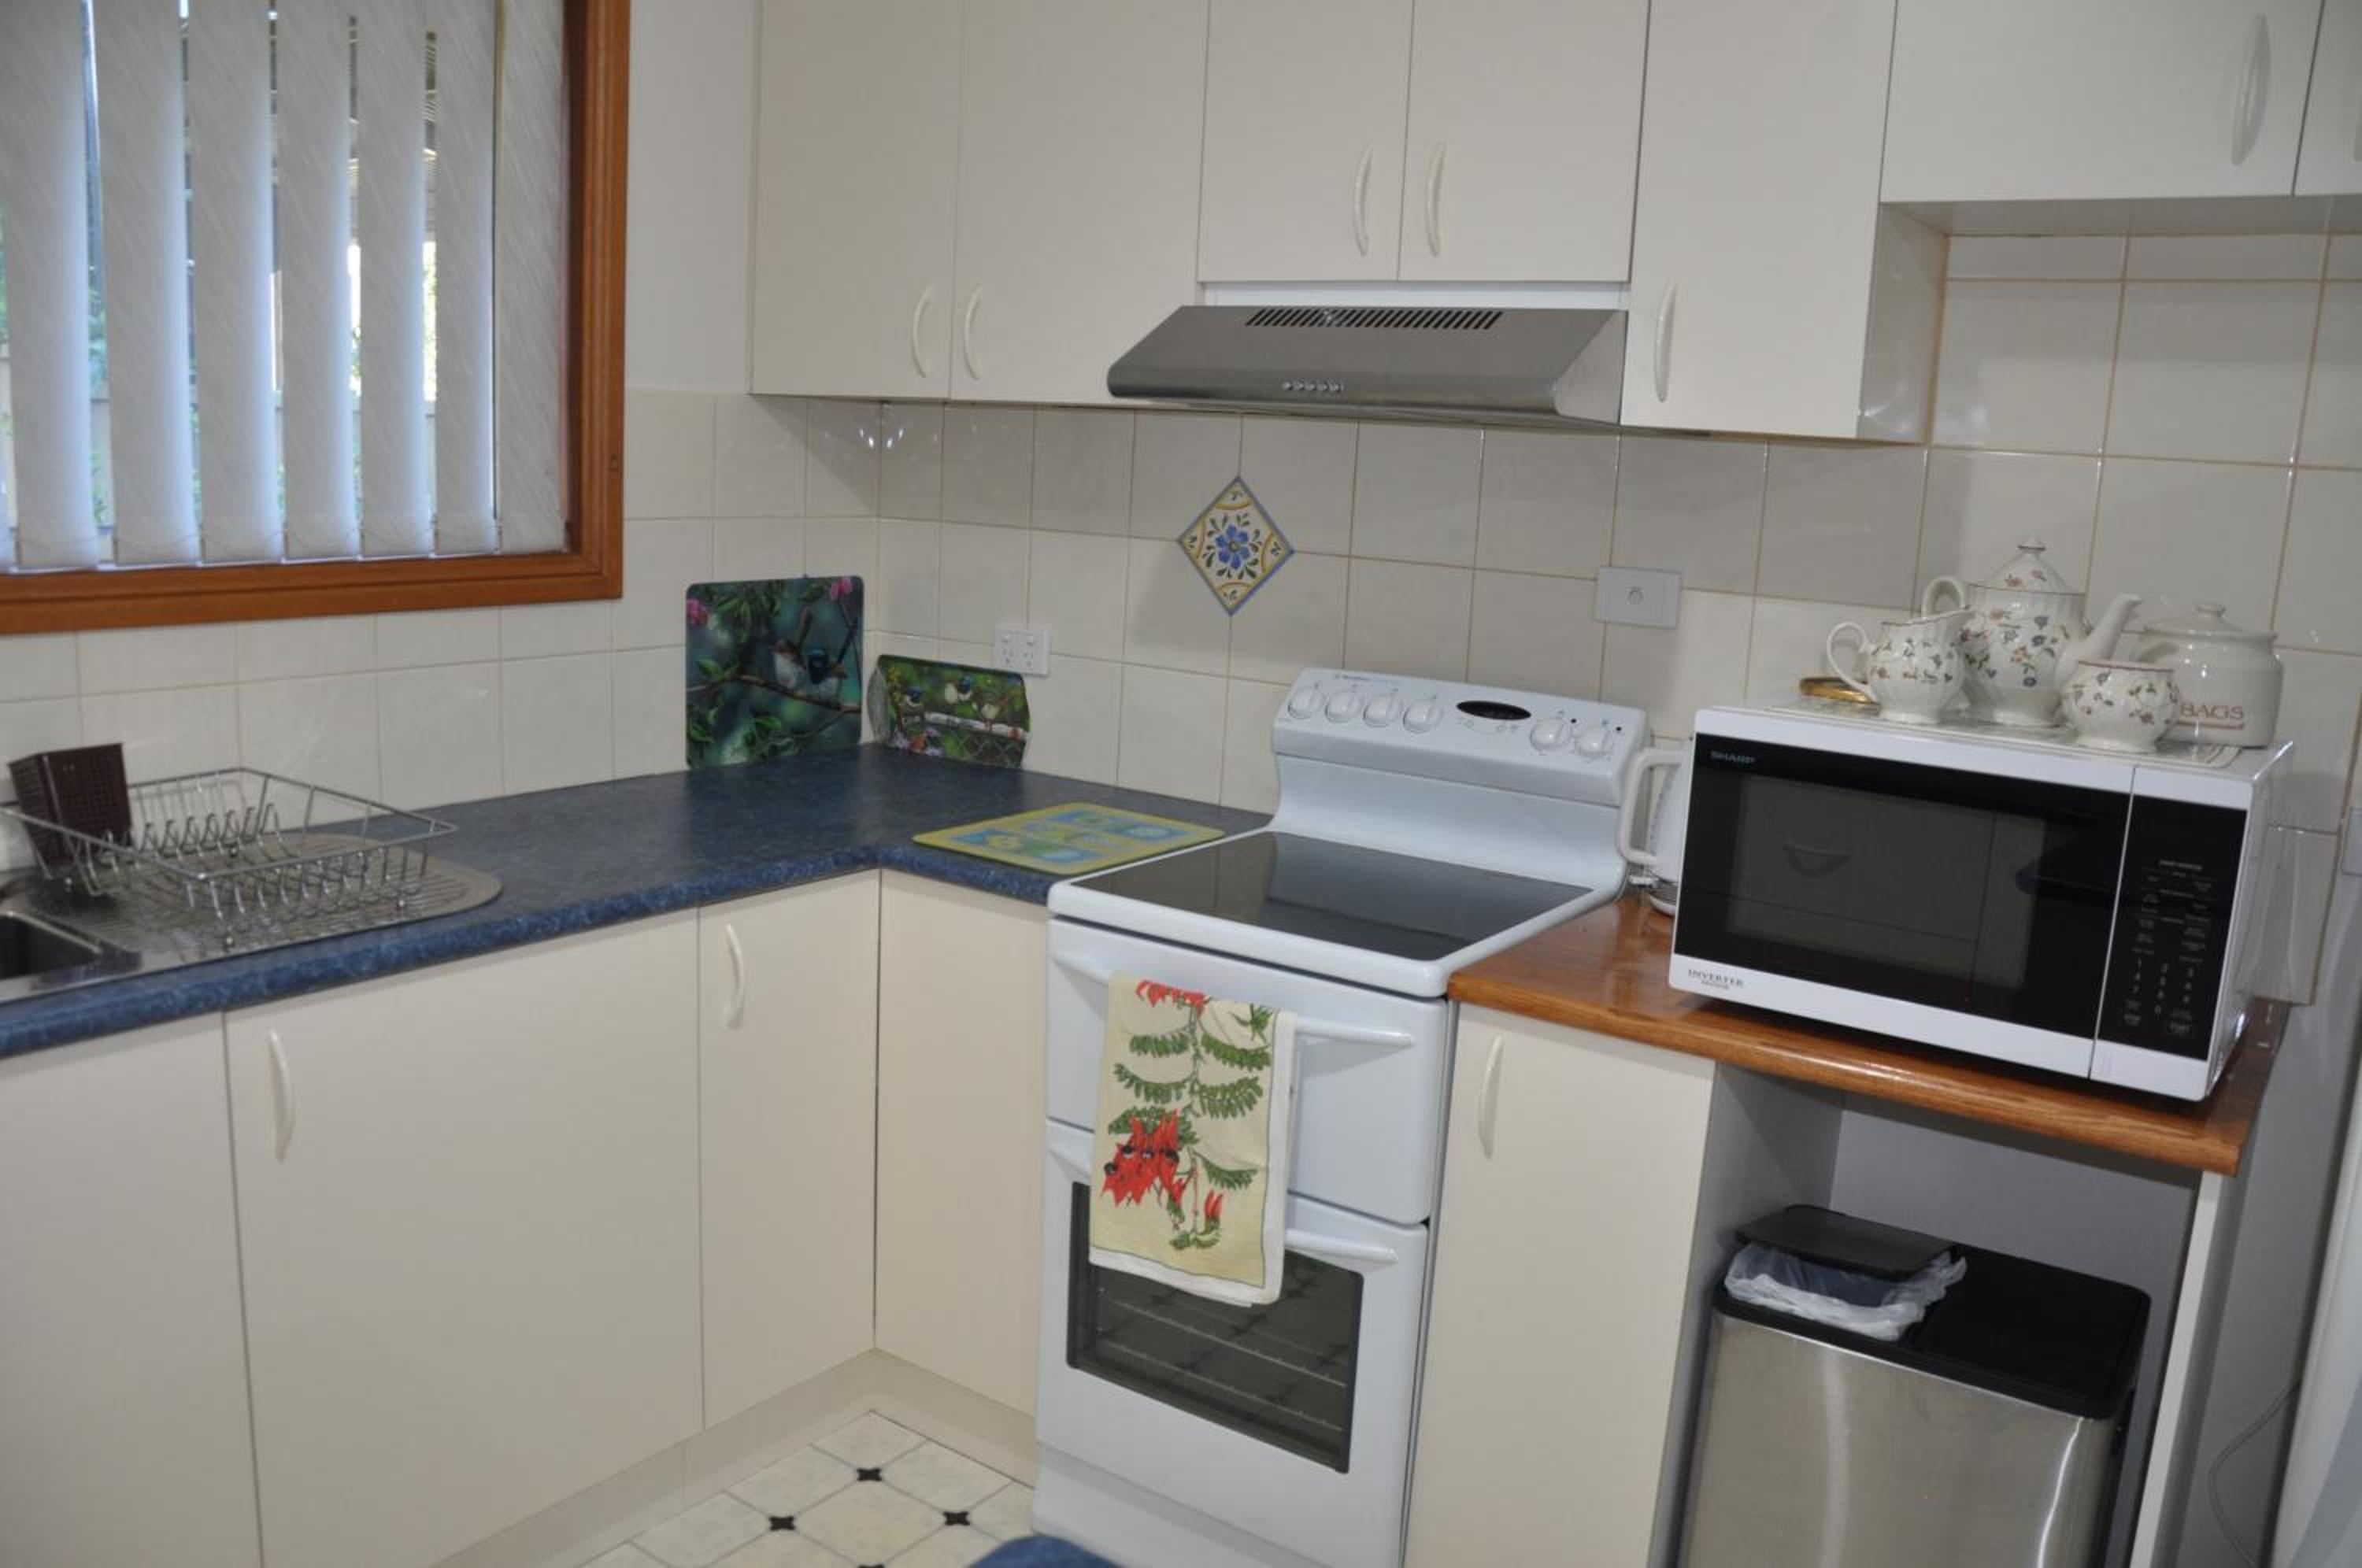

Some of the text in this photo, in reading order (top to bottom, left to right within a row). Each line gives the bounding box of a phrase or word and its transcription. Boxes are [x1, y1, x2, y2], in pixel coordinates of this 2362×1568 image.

[2179, 704, 2243, 719] BAGS
[1710, 750, 1756, 764] SHARP
[1688, 968, 1744, 988] INVERTER
